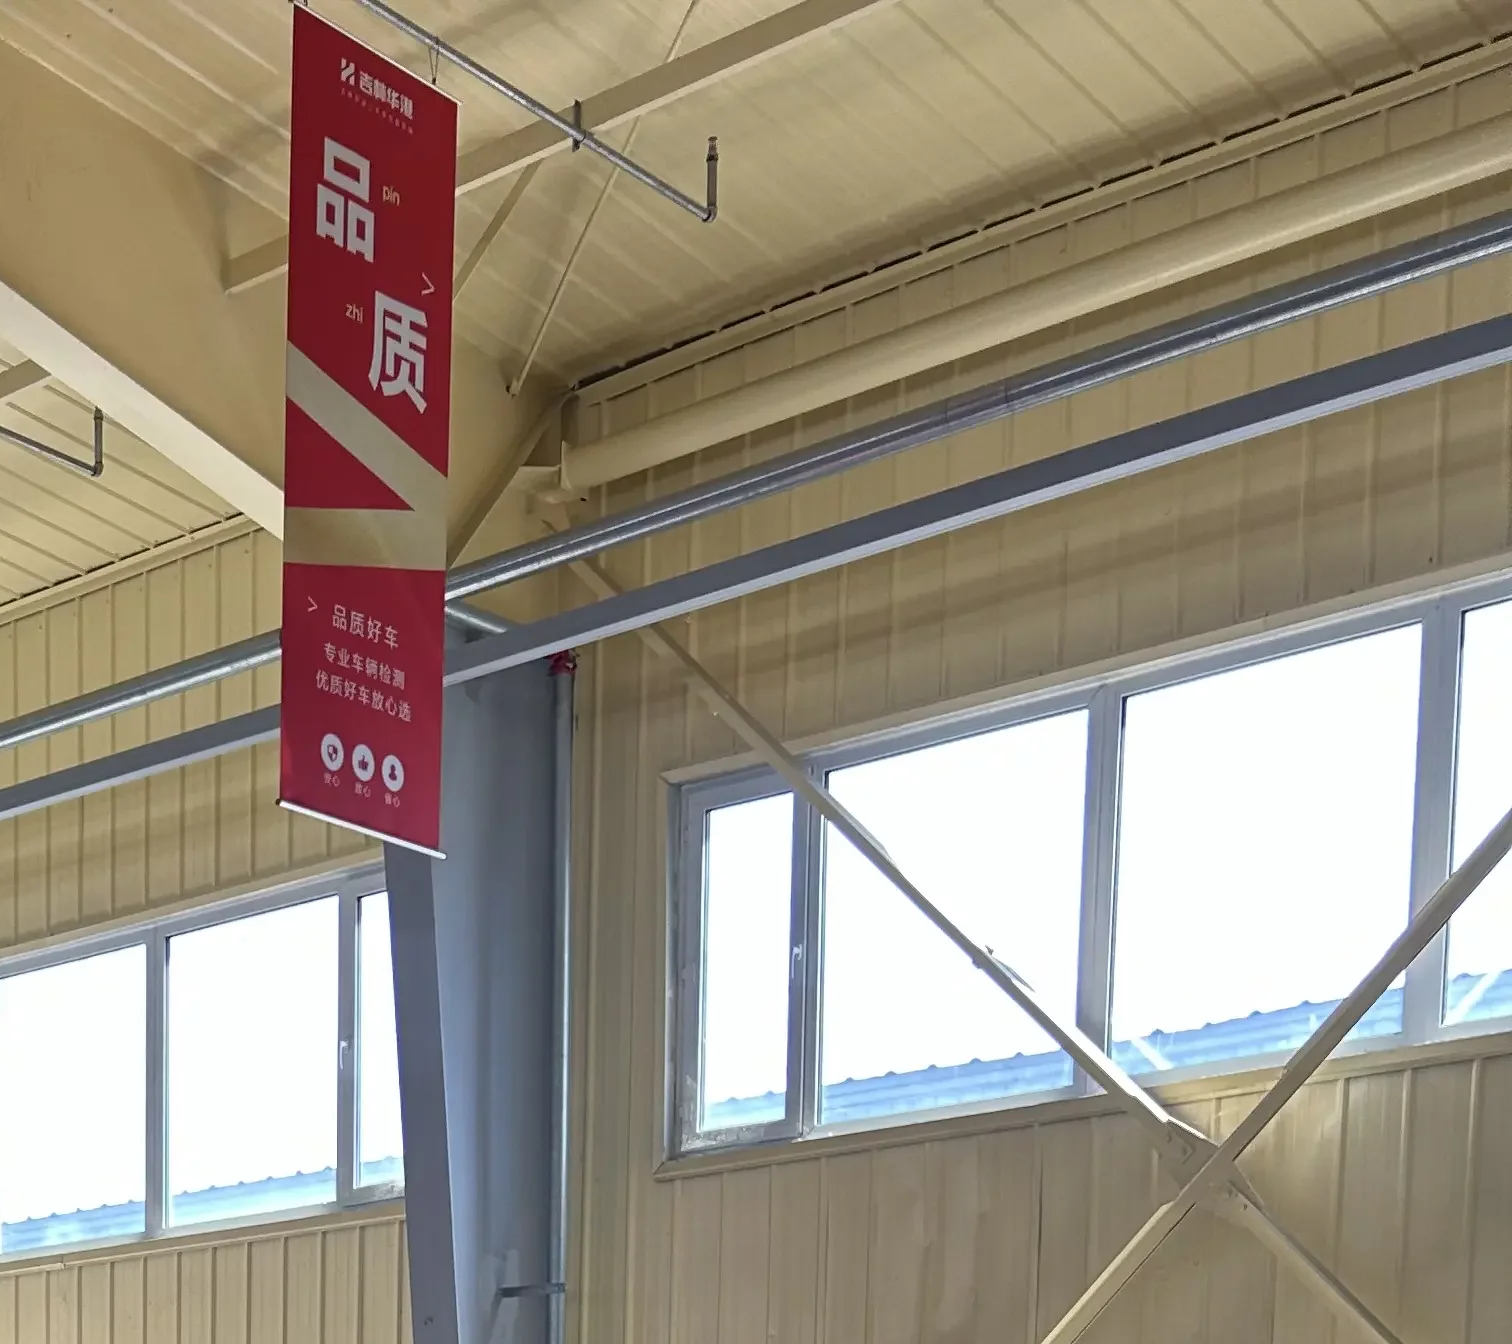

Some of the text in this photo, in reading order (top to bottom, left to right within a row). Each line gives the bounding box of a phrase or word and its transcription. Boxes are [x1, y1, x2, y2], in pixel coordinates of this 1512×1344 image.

[332, 604, 399, 651] 品质好车
[324, 641, 405, 691] 专业车辆检测
[316, 669, 411, 722] 优质好车放心选
